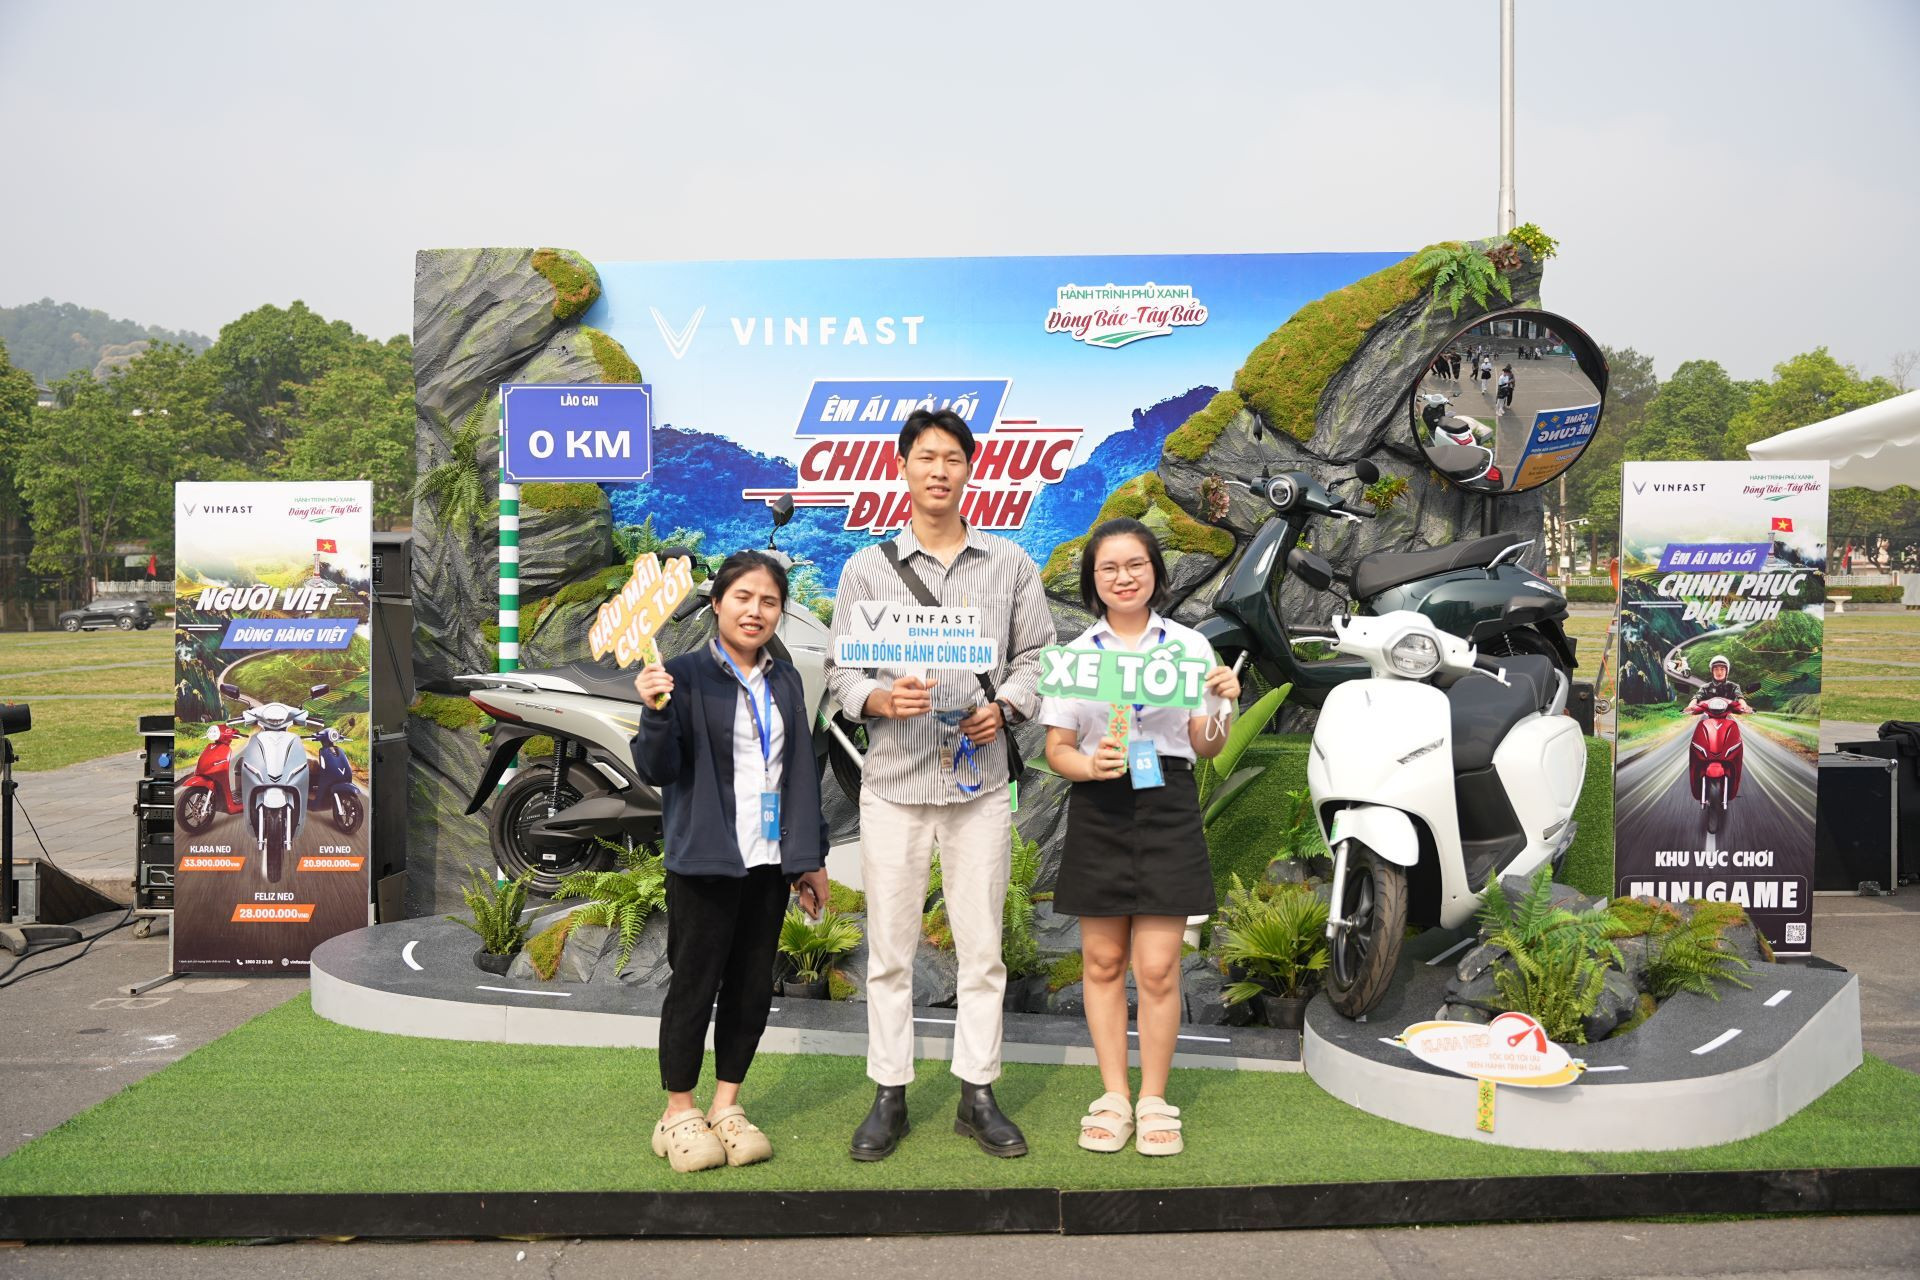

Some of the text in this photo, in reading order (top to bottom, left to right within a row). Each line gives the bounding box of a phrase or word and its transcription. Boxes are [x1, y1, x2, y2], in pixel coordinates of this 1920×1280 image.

[1061, 286, 1188, 299] HÀNH TRÌNH PHỦ XANH
[730, 316, 924, 346] VINFAST
[1048, 309, 1094, 336] Đông
[1094, 306, 1128, 326] Bắc
[1170, 302, 1206, 322] Bắc
[560, 394, 598, 406] LÀO CAI
[820, 395, 860, 421] ÊM
[859, 395, 890, 421] ÁI
[566, 430, 630, 458] KM
[800, 439, 902, 481] CHIN
[1654, 484, 1706, 492] VINFAST
[203, 505, 253, 514] VINFAST
[960, 484, 1032, 526] ÌNH
[1670, 548, 1757, 565] ÊM ÁI MỞ LỐI
[195, 583, 337, 613] NGƯỜI VIỆT
[652, 561, 688, 616] TỐT
[1658, 574, 1807, 599] CHINH PHỤC
[892, 614, 975, 624] VINFAST
[1682, 597, 1784, 623] ĐỊA HÌNH
[233, 626, 348, 644] DÙNG HÀNG VIỆT
[943, 628, 974, 637] MINH
[841, 638, 992, 667] LUÔN ĐỒNG HÀNH CÙNG BẠN
[1042, 644, 1206, 698] XE TỐT
[1655, 849, 1774, 868] KHU VỰC CHƠI
[255, 892, 294, 900] FELIZ NEO
[1630, 882, 1798, 908] MINIGAME
